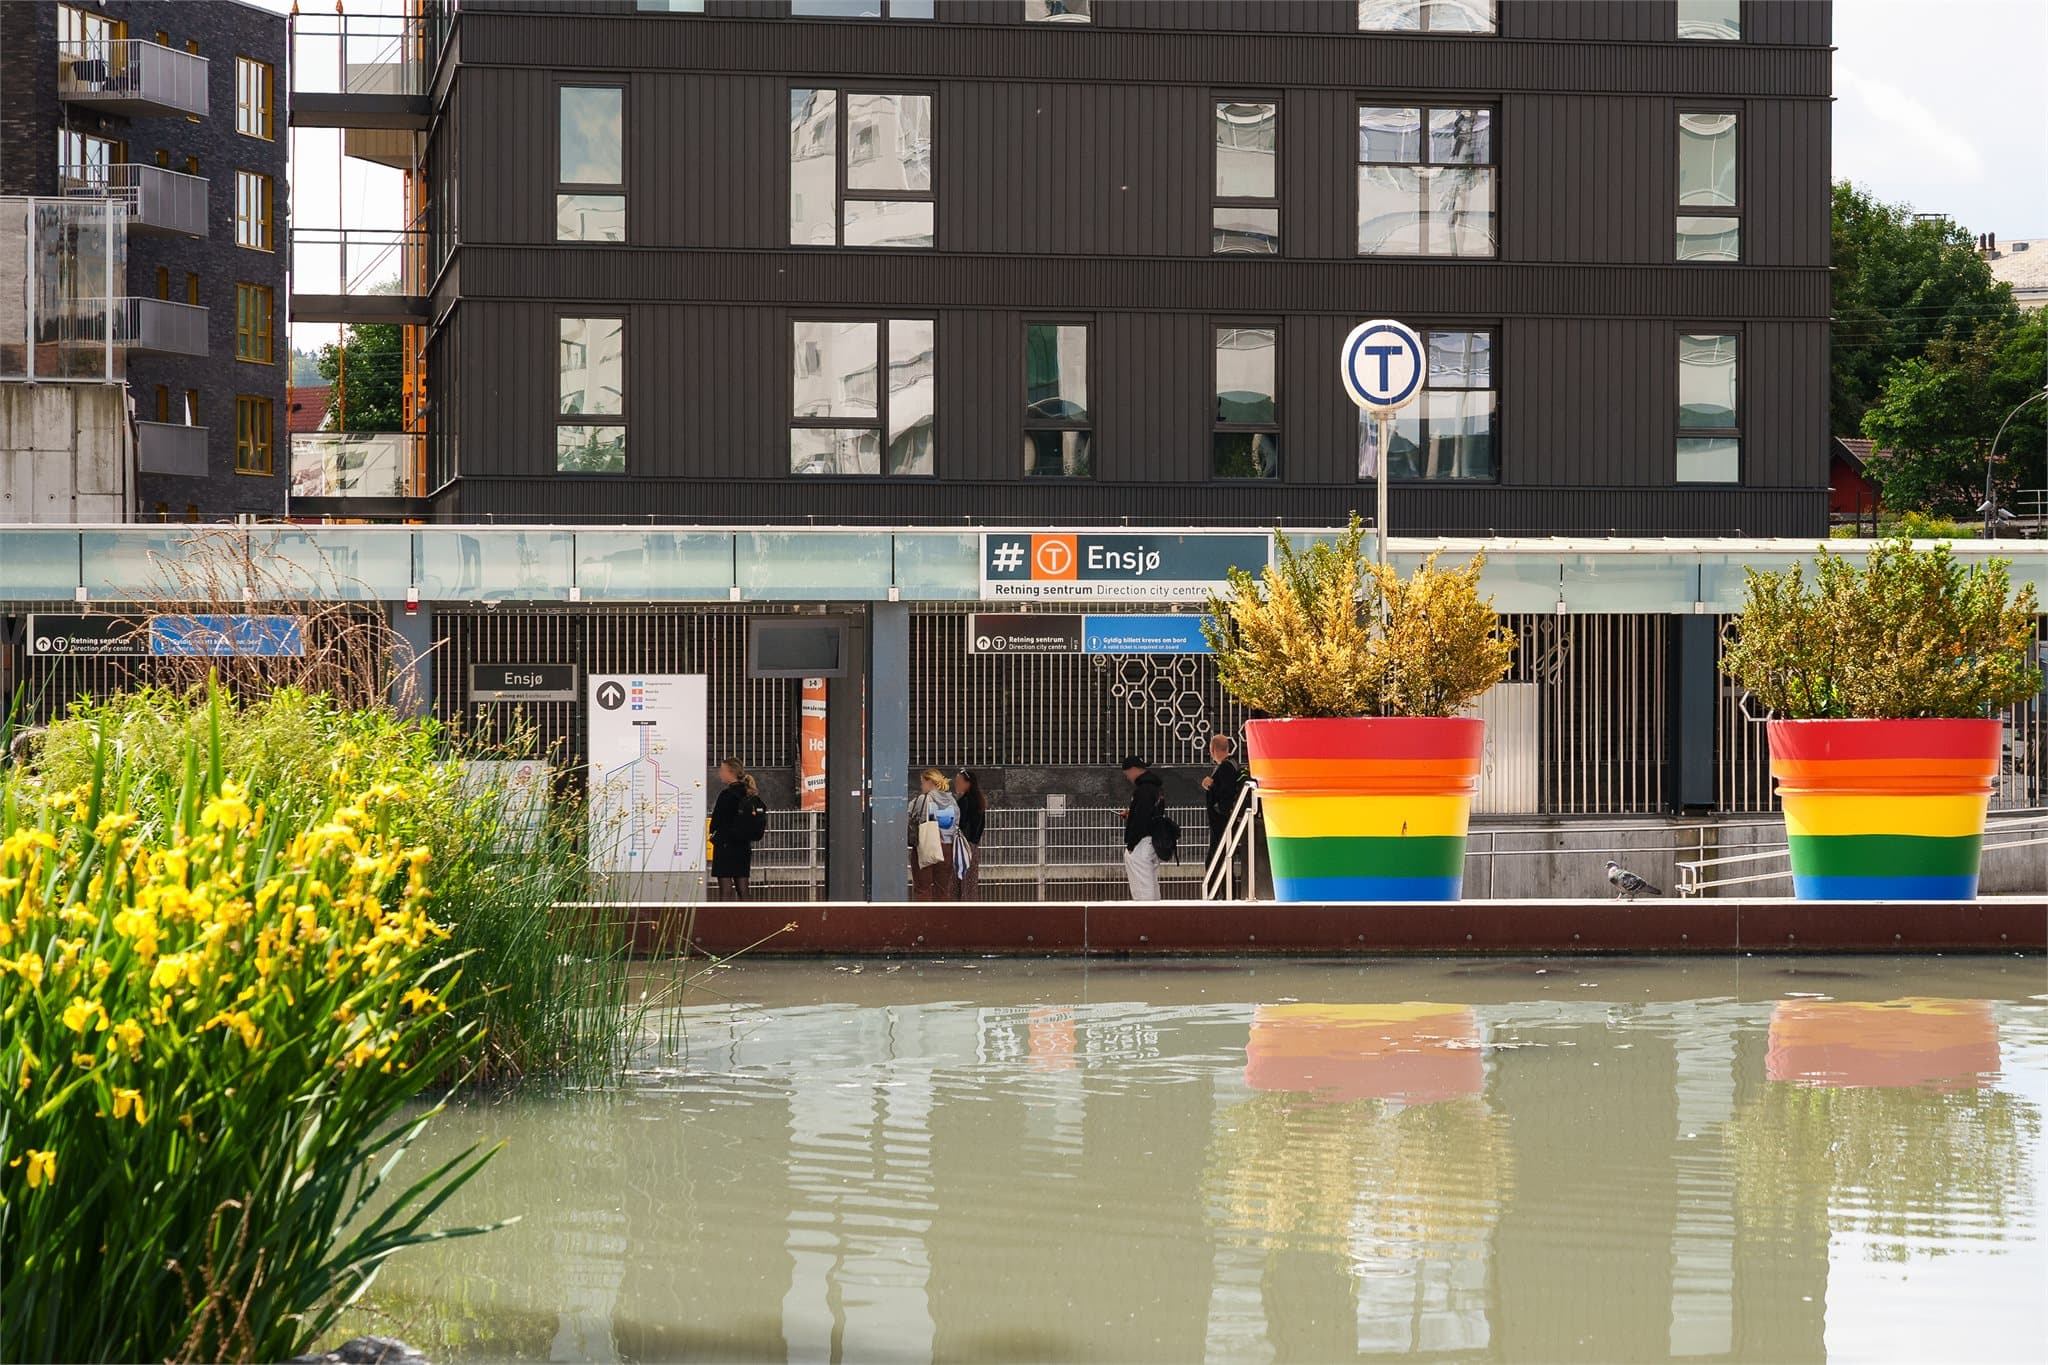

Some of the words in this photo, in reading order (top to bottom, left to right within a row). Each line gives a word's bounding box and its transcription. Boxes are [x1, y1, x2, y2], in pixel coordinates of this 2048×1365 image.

[1365, 346, 1402, 392] T
[1088, 545, 1160, 575] Ensjø
[995, 584, 1040, 596] Retning
[1043, 585, 1093, 595] sentrum
[1097, 584, 1146, 596] Direction
[1150, 584, 1169, 596] city
[1172, 587, 1207, 596] centre
[505, 672, 543, 687] Ensjø
